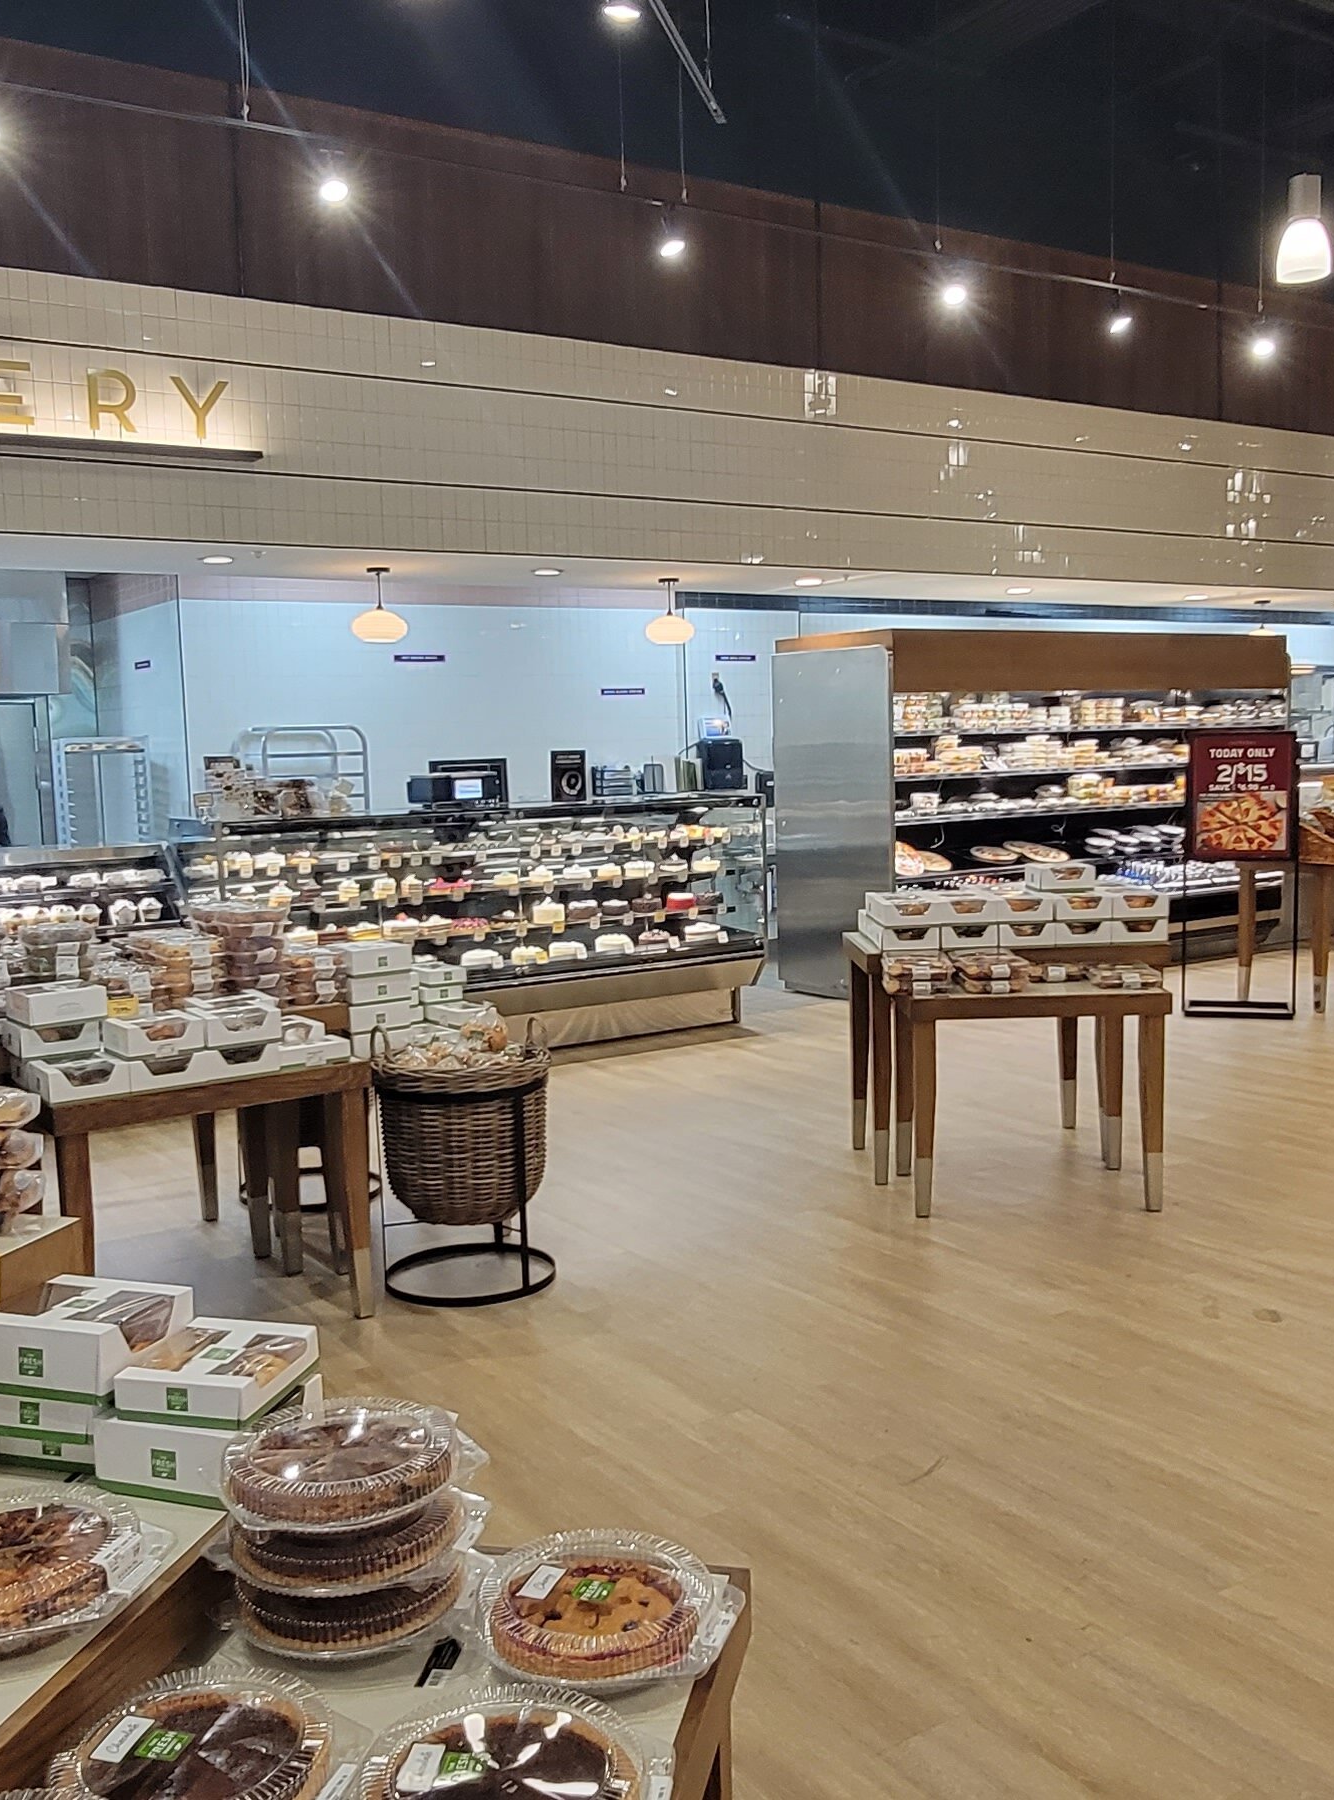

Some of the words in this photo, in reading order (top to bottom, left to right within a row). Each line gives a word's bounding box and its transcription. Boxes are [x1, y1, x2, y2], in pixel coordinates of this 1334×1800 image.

[1209, 748, 1244, 758] TODAY
[1247, 748, 1276, 758] ONLY
[147, 1731, 179, 1758] FRESH
